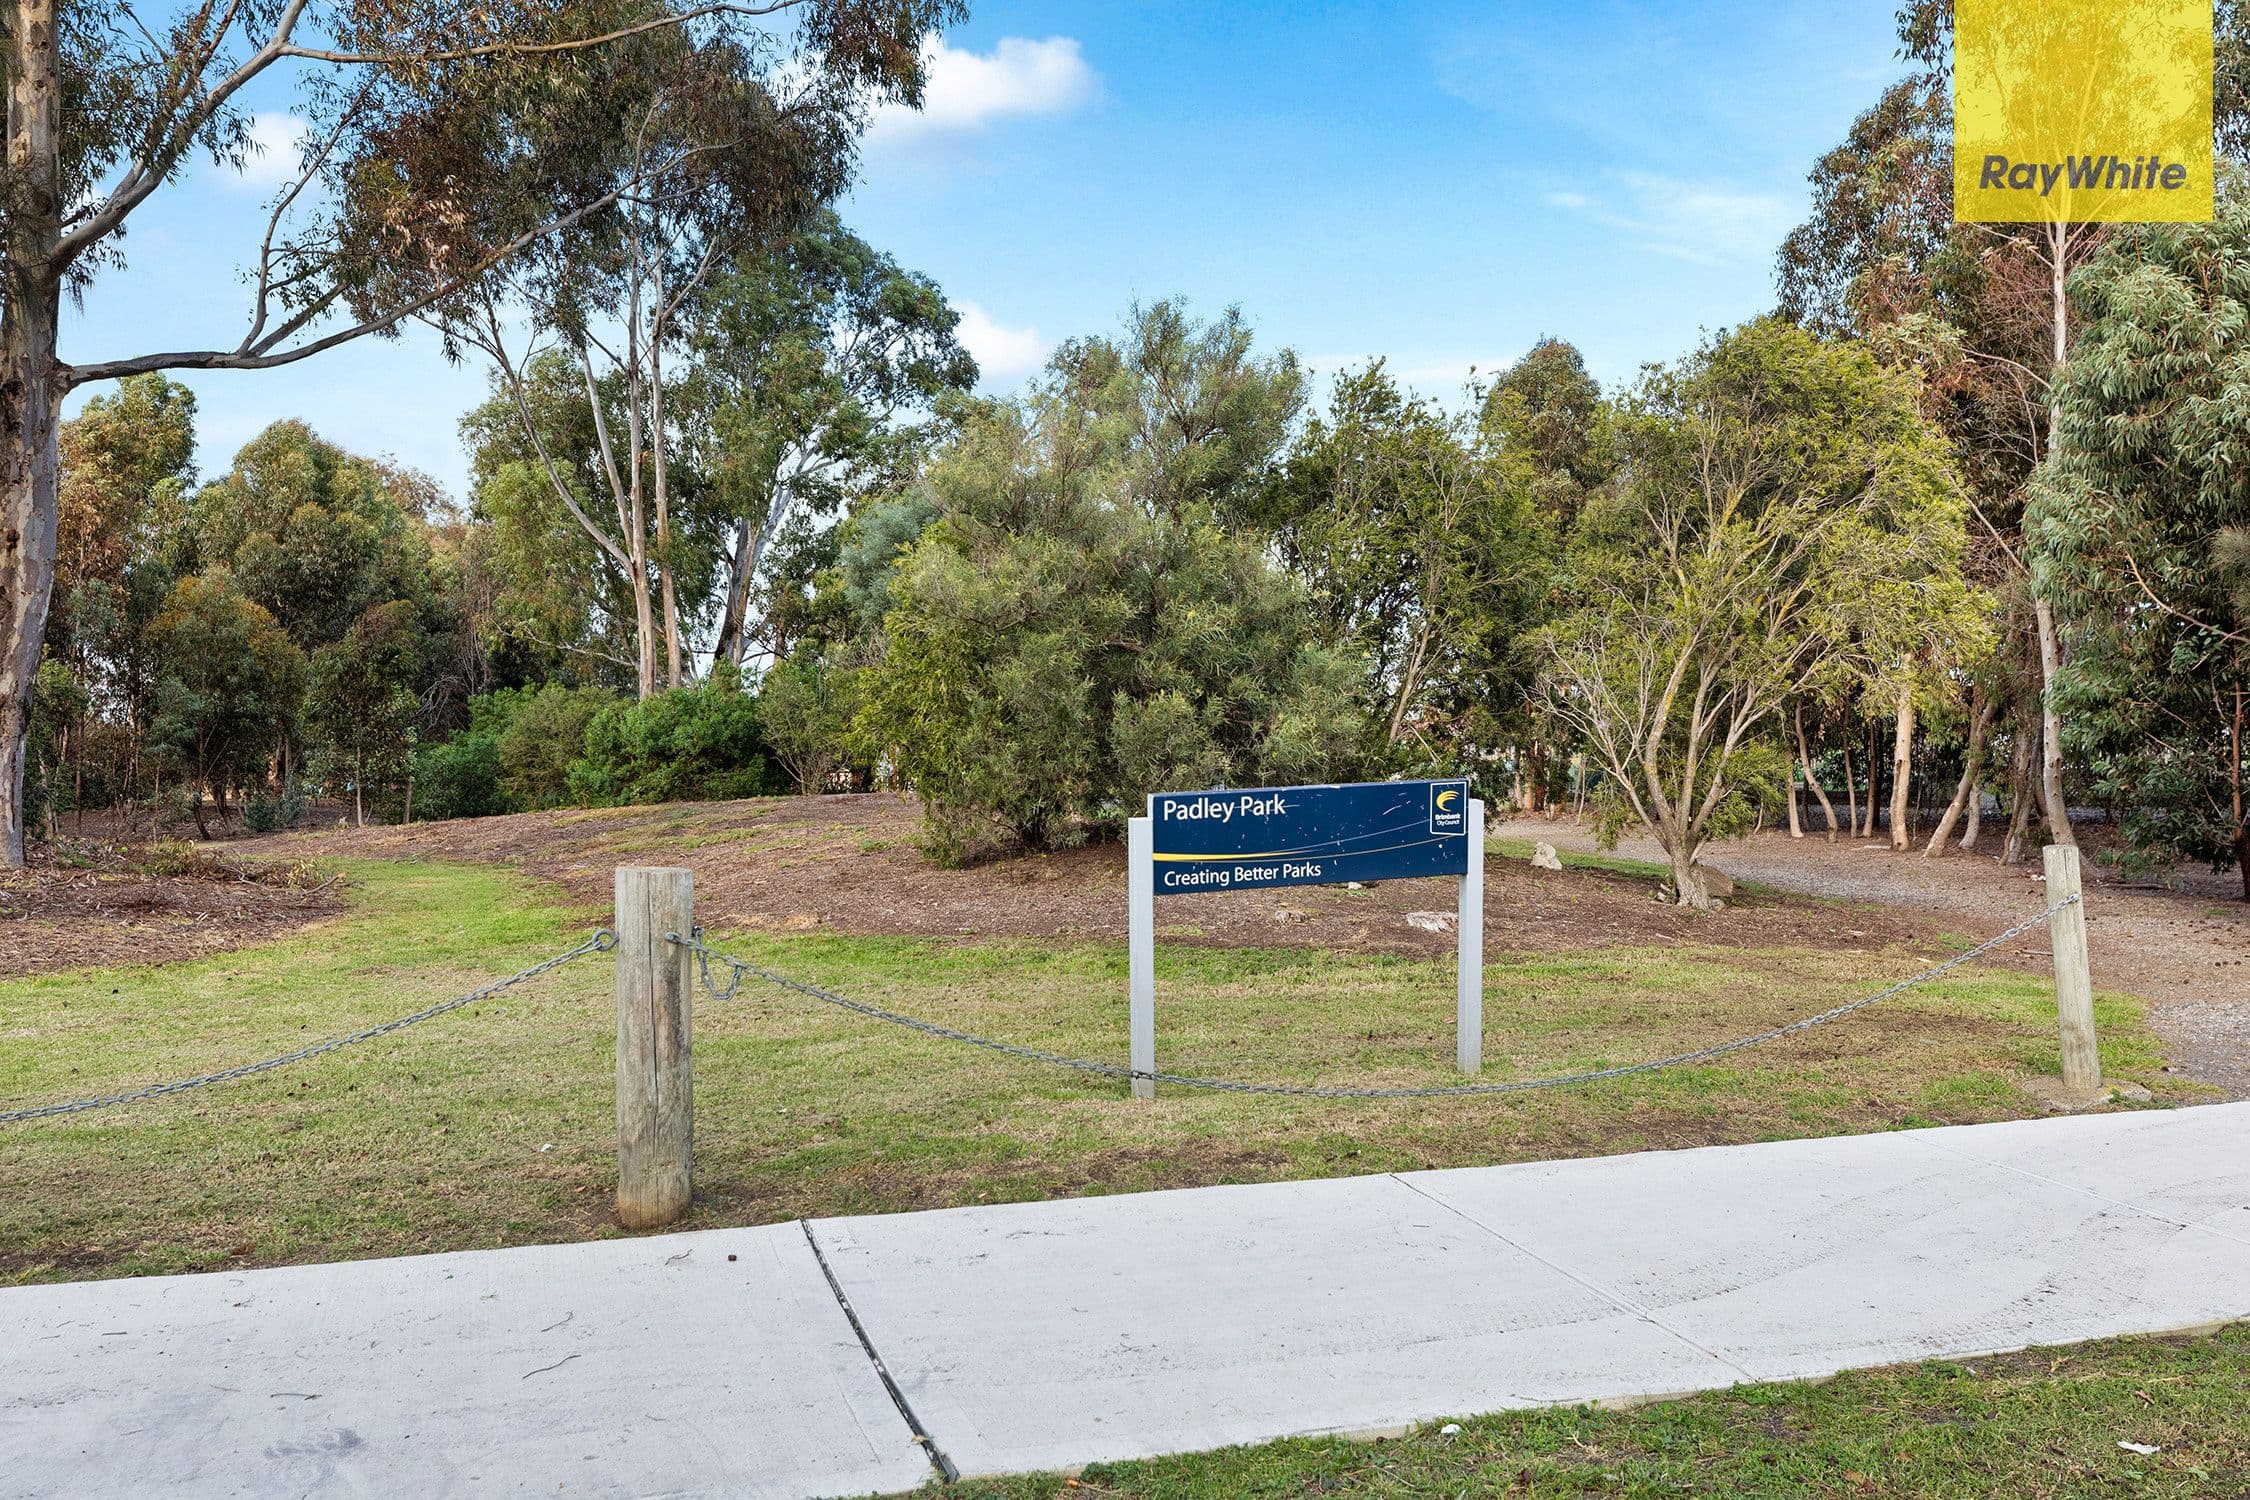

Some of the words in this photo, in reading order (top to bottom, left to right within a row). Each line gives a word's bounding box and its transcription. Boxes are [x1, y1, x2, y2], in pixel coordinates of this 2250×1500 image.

[1163, 797, 1234, 822] Padley
[1240, 794, 1286, 816] Park
[1164, 869, 1230, 887] Creating
[1234, 865, 1279, 882] Better
[1283, 862, 1321, 877] Parks
